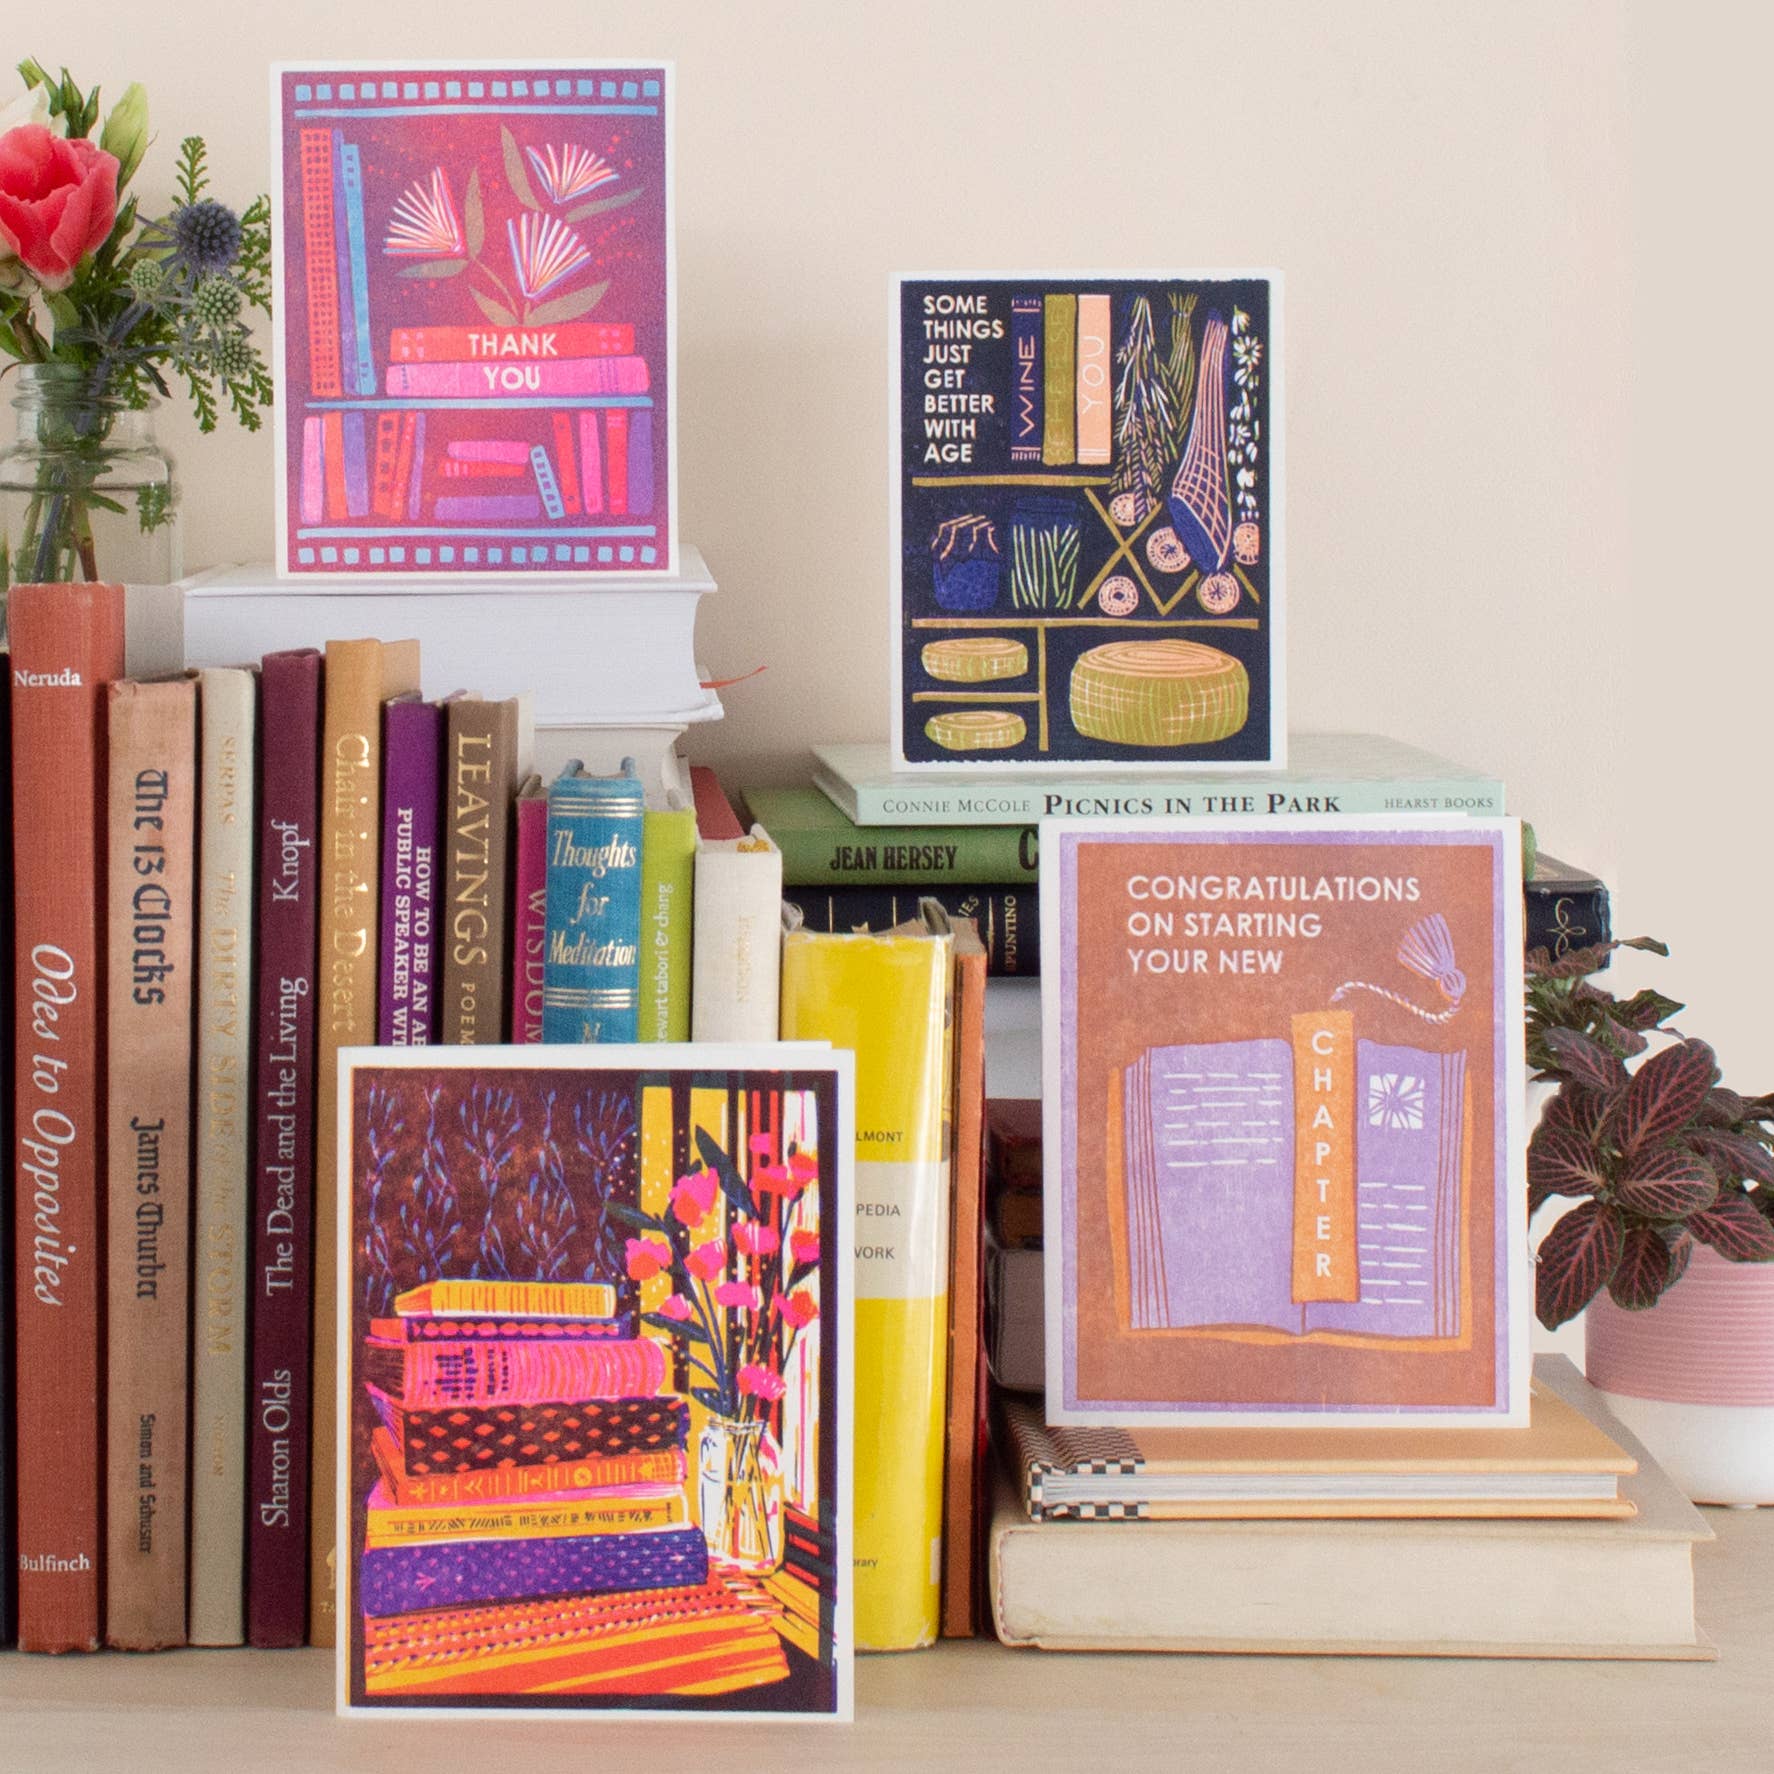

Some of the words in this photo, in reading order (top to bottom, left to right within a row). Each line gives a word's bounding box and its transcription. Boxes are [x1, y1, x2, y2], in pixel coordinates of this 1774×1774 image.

[923, 295, 987, 315] SOME
[468, 333, 558, 357] THANK
[923, 319, 1004, 339] THINGS
[923, 344, 972, 364] JUST
[1082, 335, 1105, 414] YOU
[483, 366, 541, 391] YOU
[923, 369, 965, 389] GET
[1018, 335, 1036, 437] WINE
[924, 394, 995, 415] BETTER
[924, 419, 976, 439] WITH
[924, 443, 973, 464] AGE
[14, 669, 82, 688] Neruda
[134, 768, 169, 832] The
[334, 734, 370, 821] Chair
[882, 799, 950, 813] CONNIE
[1043, 793, 1154, 815] PICNICS
[1163, 796, 1192, 814] IN
[1202, 795, 1255, 813] THE
[1266, 793, 1342, 814] PARK
[1384, 797, 1438, 809] HEARST
[1444, 797, 1494, 808] BOOKS
[133, 843, 166, 877] 13
[272, 820, 311, 902] Knopf
[334, 829, 369, 861] in
[395, 807, 414, 890] PUBLIC
[453, 732, 492, 966] LEAVINGS
[552, 829, 637, 878] Thoughts
[830, 846, 877, 870] JEAN
[883, 846, 957, 871] HERSEY
[333, 869, 369, 919] the
[415, 846, 433, 901] HOW
[1126, 875, 1421, 902] CONGRATULATIONS
[415, 907, 431, 938] TO
[569, 882, 610, 924] for
[1127, 911, 1174, 938] ON
[1184, 912, 1322, 938] STARTING
[131, 883, 176, 1007] Clocks
[393, 895, 412, 1001] SPEAKER
[413, 942, 429, 974] BE
[548, 930, 637, 968] Meditation
[1127, 948, 1208, 975] YOUR
[1220, 949, 1283, 974] NEW
[31, 943, 78, 1041] Odes
[210, 926, 239, 1038] DIRTY
[331, 927, 367, 1034] Desert
[653, 950, 669, 995] tabori
[412, 979, 428, 1013] AN
[271, 975, 310, 1064] Living
[655, 997, 670, 1043] ewart
[32, 1054, 69, 1096] to
[207, 1050, 238, 1138] SIDE
[271, 1065, 298, 1111] the
[129, 1116, 164, 1195] James
[269, 1113, 297, 1158] and
[1311, 1029, 1336, 1278] CHAPTER
[21, 1110, 78, 1306] Opposites
[266, 1161, 296, 1237] Dead
[856, 1203, 901, 1218] PEDIA
[136, 1200, 173, 1302] Thurber
[266, 1242, 296, 1295] The
[206, 1223, 237, 1356] STORM
[263, 1367, 291, 1430] Olds
[262, 1436, 291, 1528] Sharon
[19, 1553, 91, 1573] Bulfinch
